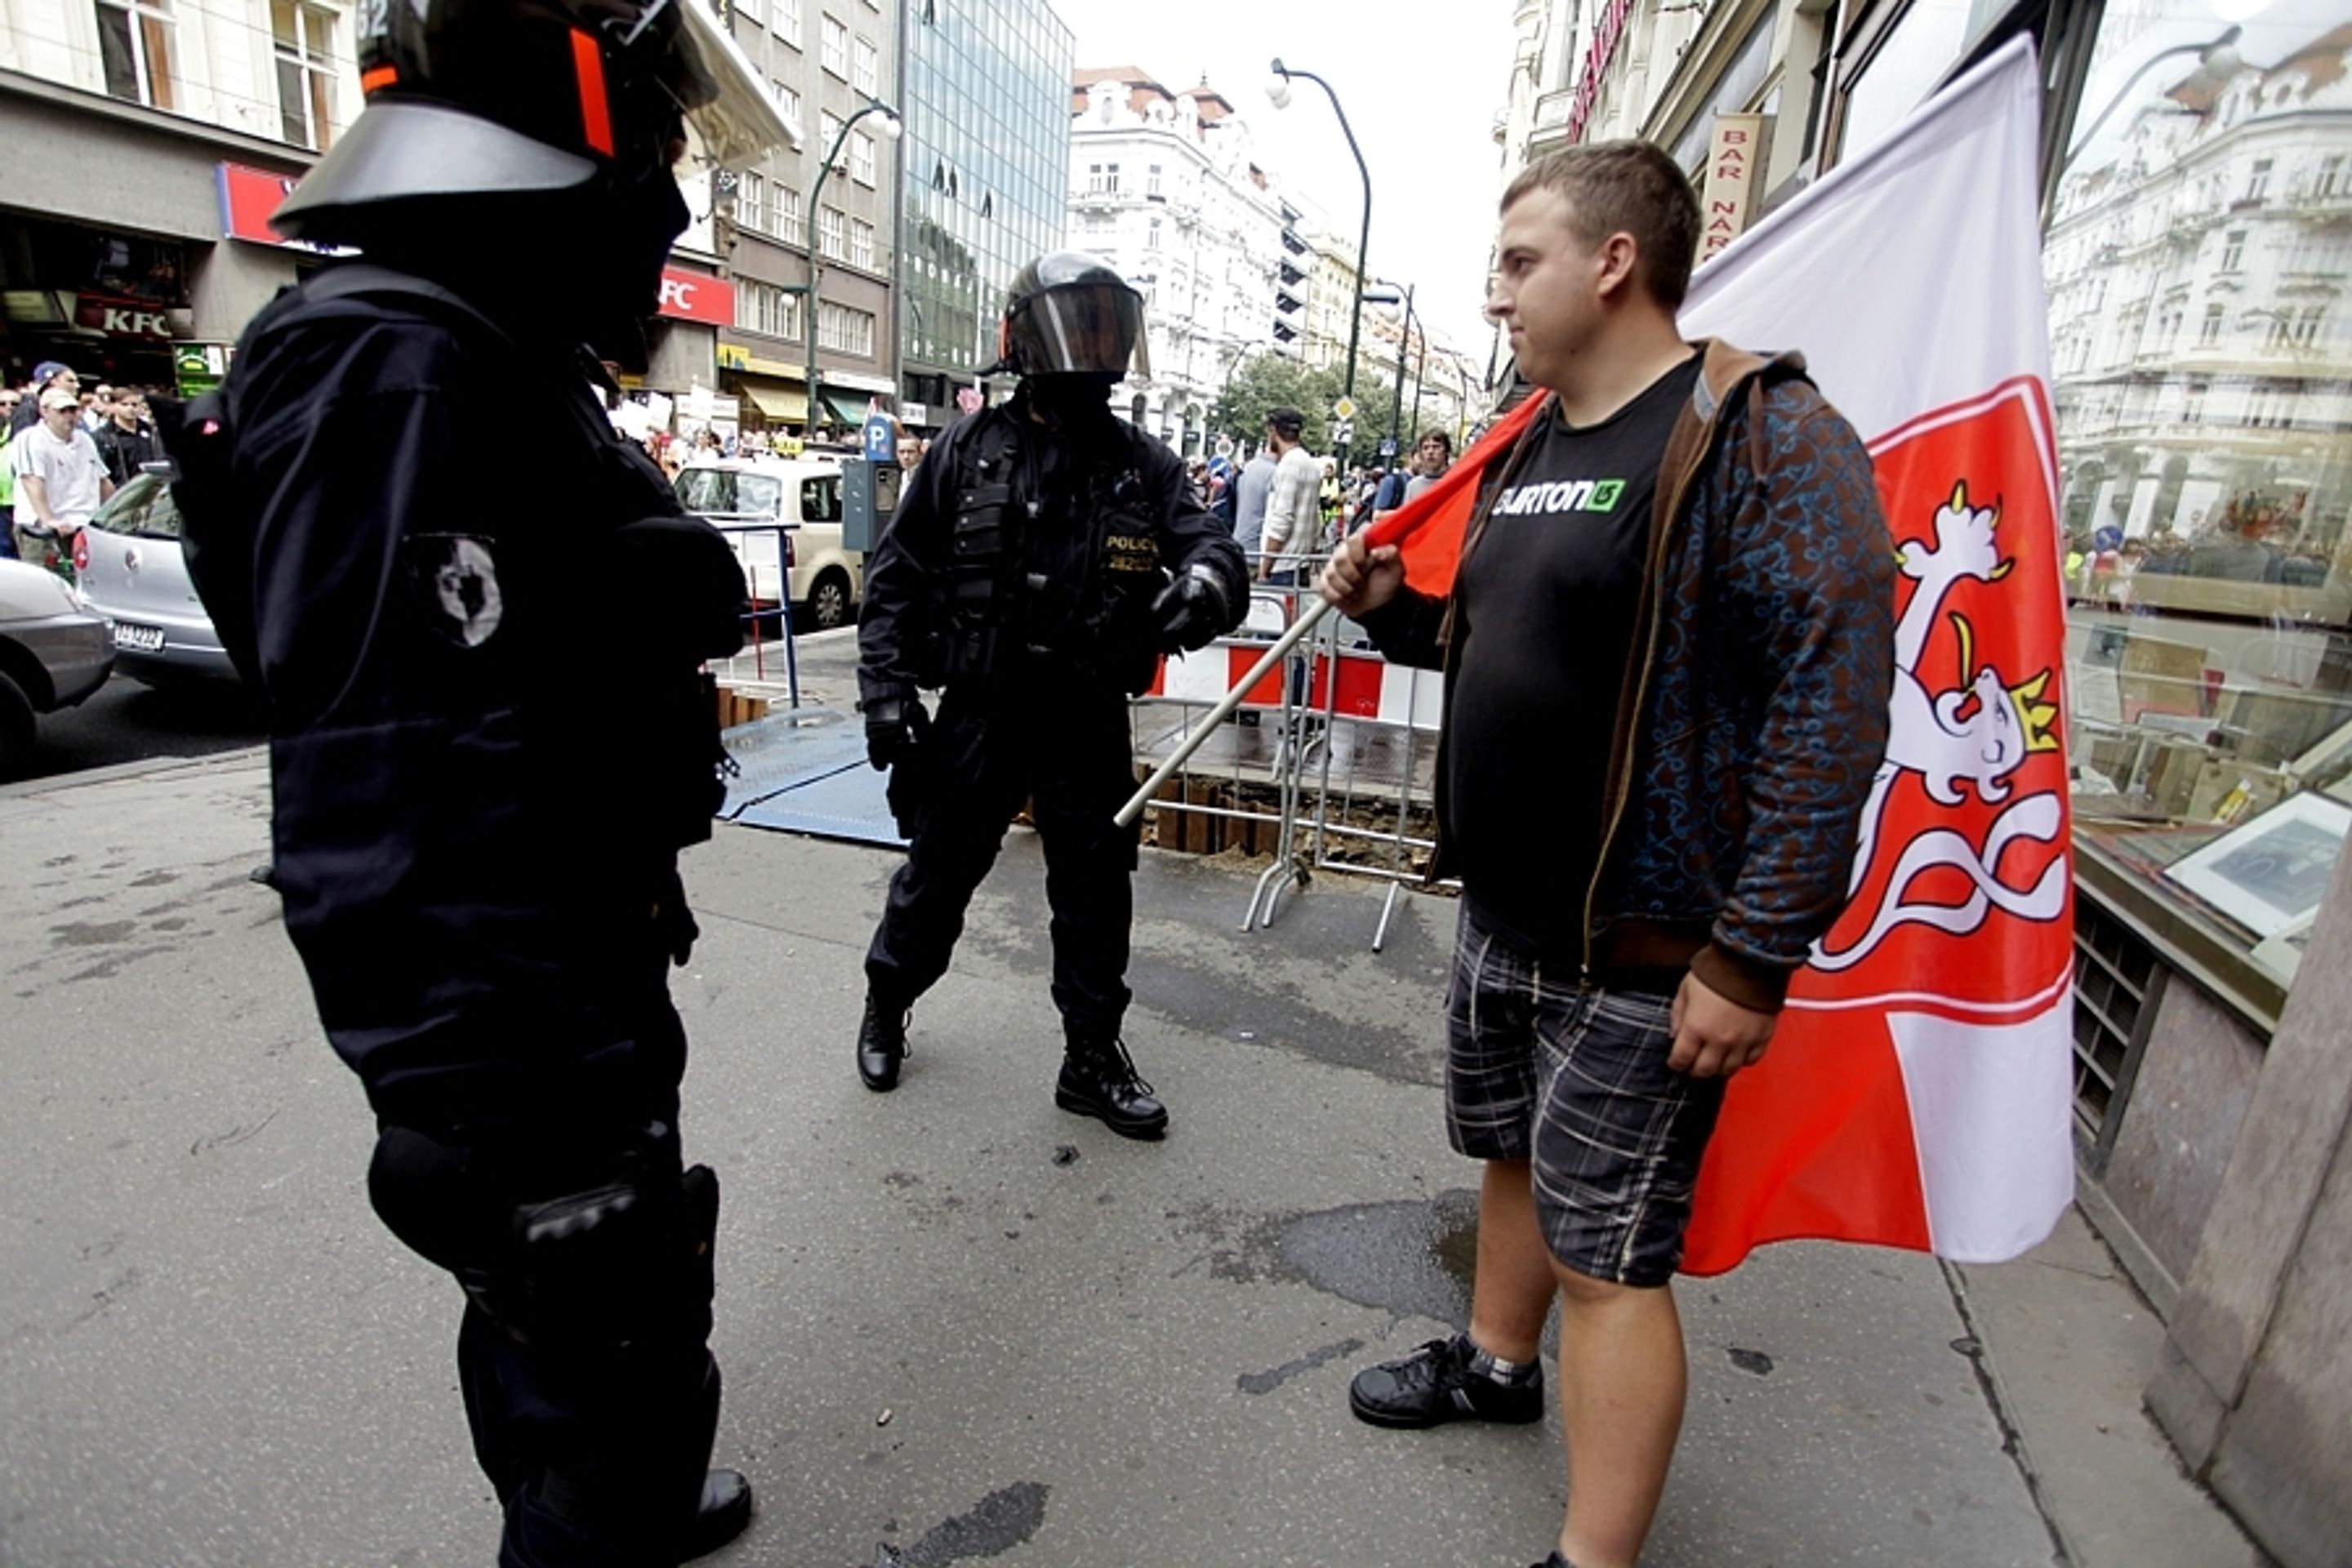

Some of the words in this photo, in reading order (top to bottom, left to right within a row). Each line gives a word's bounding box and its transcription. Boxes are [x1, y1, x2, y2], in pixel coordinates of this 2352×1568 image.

[1717, 131, 1747, 179] BAR
[658, 278, 698, 310] FC
[103, 308, 172, 336] KFC
[870, 425, 885, 451] P
